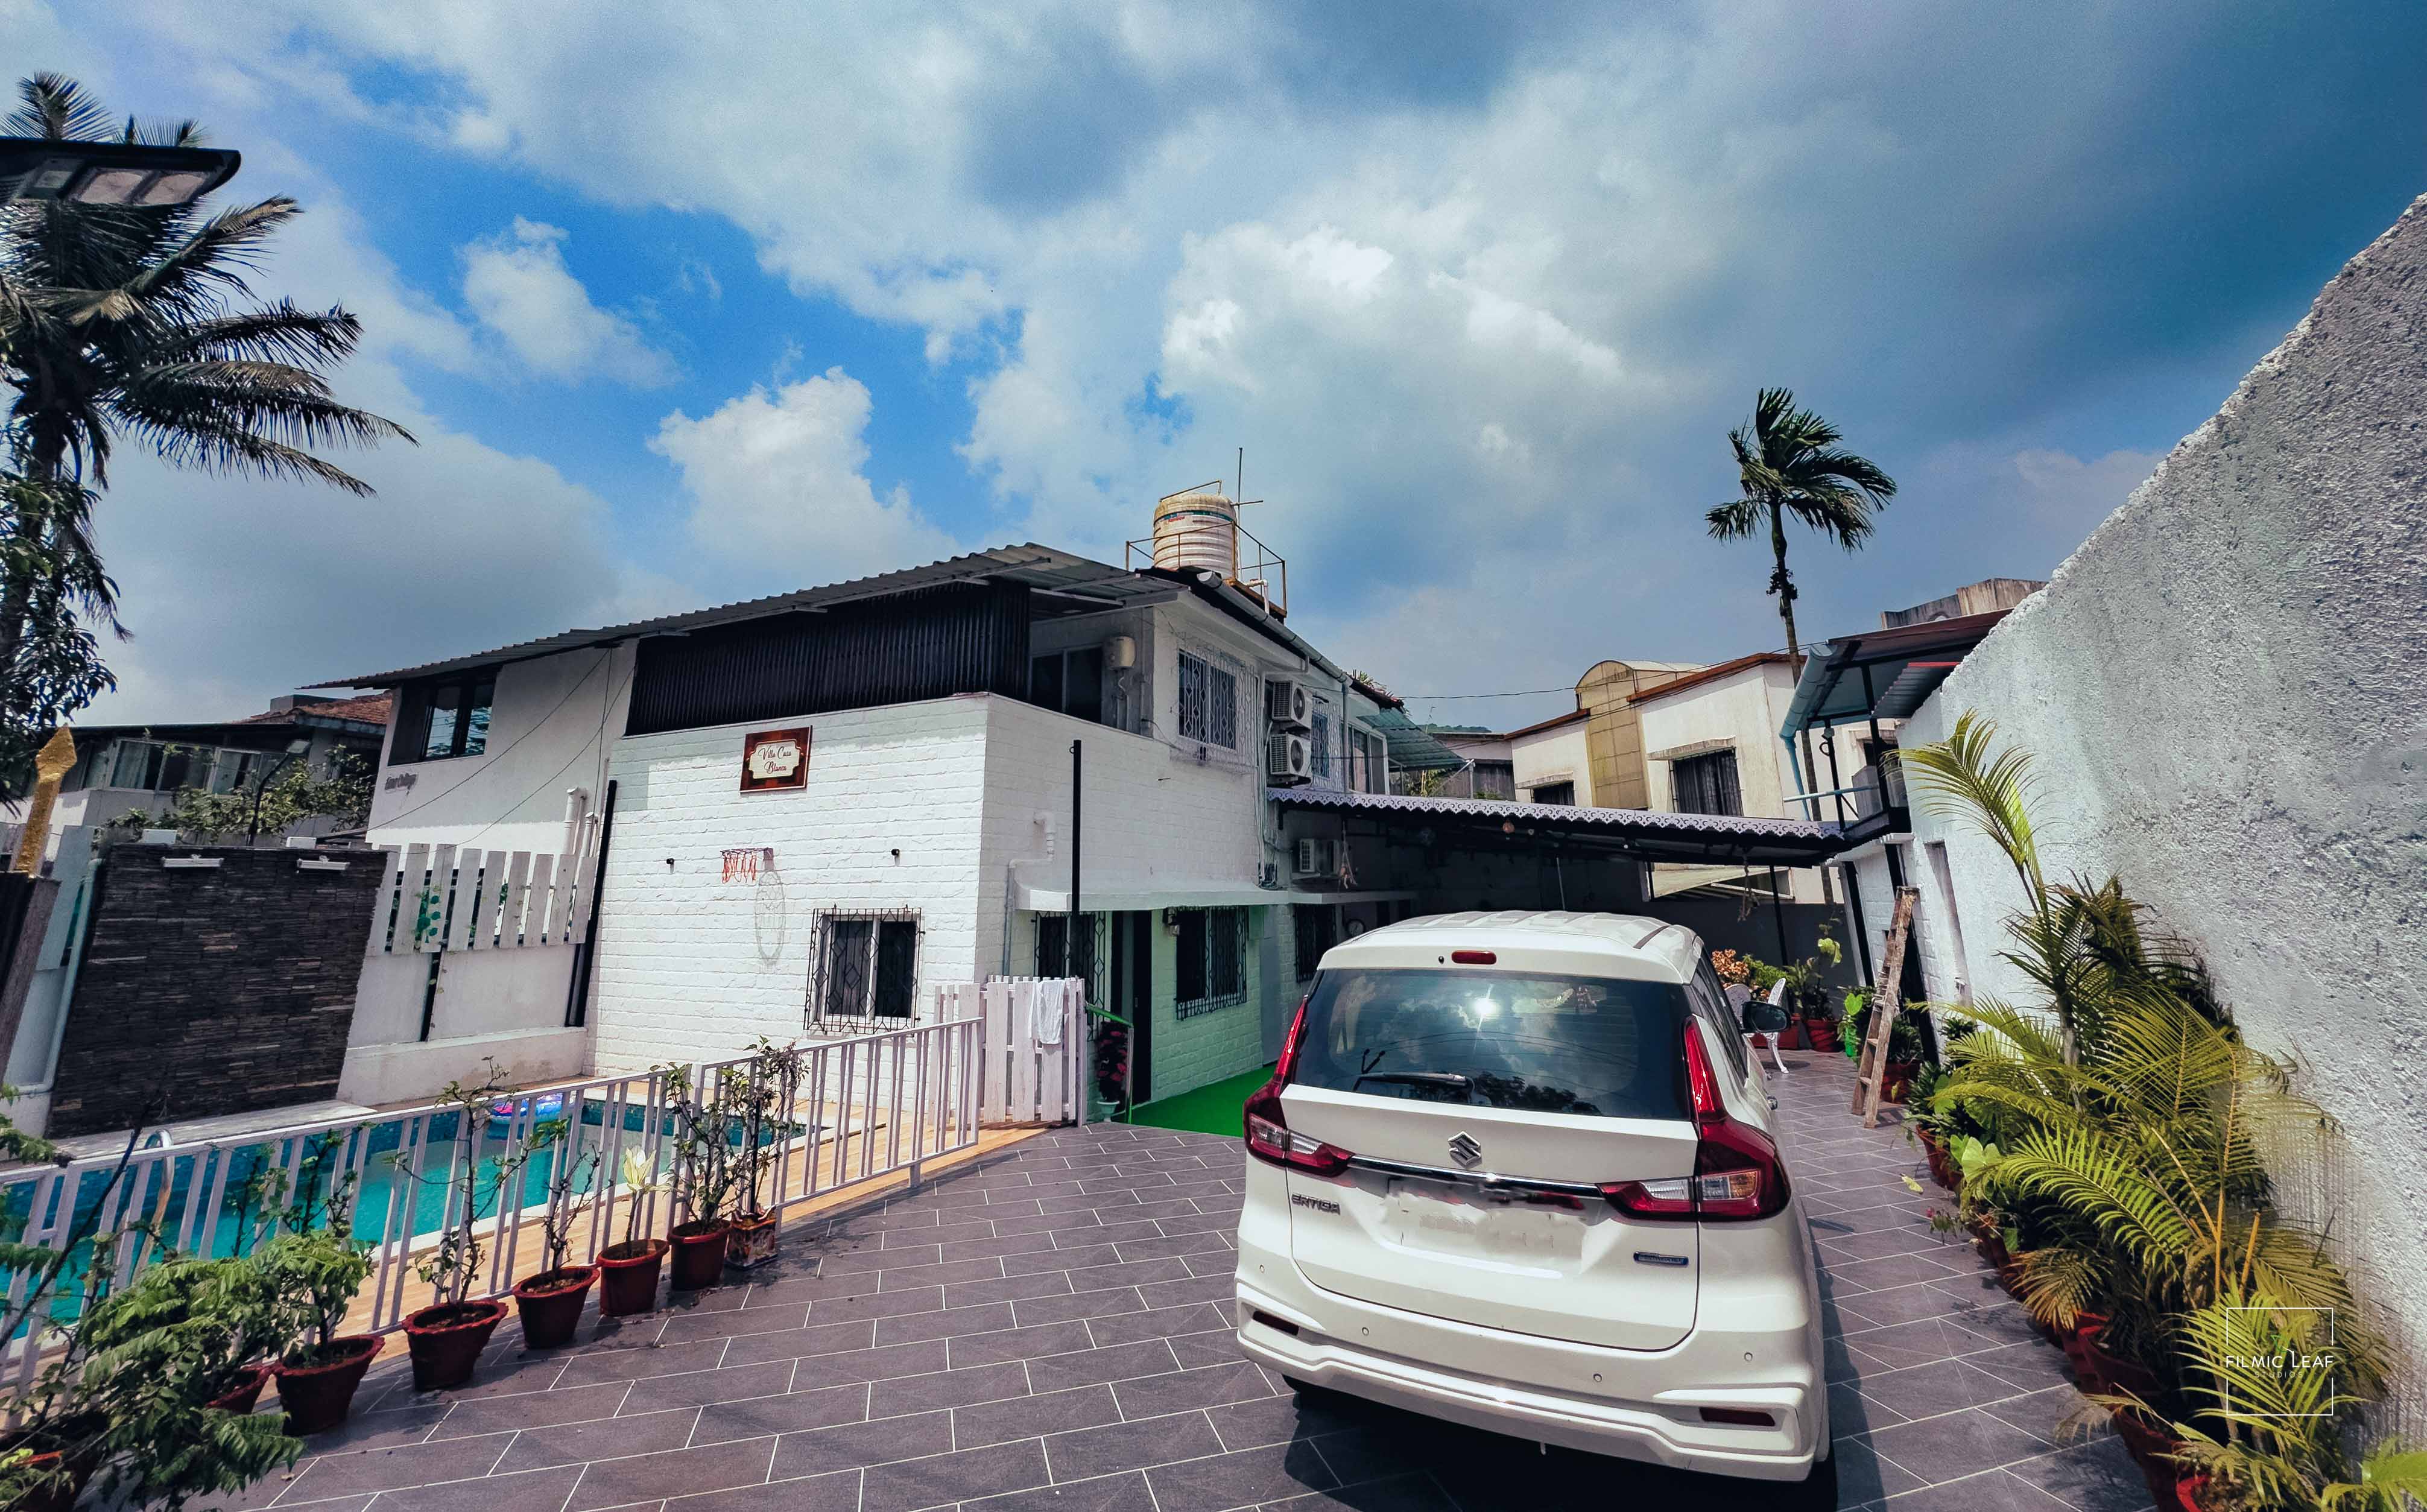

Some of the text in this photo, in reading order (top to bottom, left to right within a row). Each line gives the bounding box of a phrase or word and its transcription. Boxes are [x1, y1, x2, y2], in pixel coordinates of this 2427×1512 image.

[758, 745, 791, 760] Villa Casa
[1292, 1194, 1341, 1216] ERTIGA
